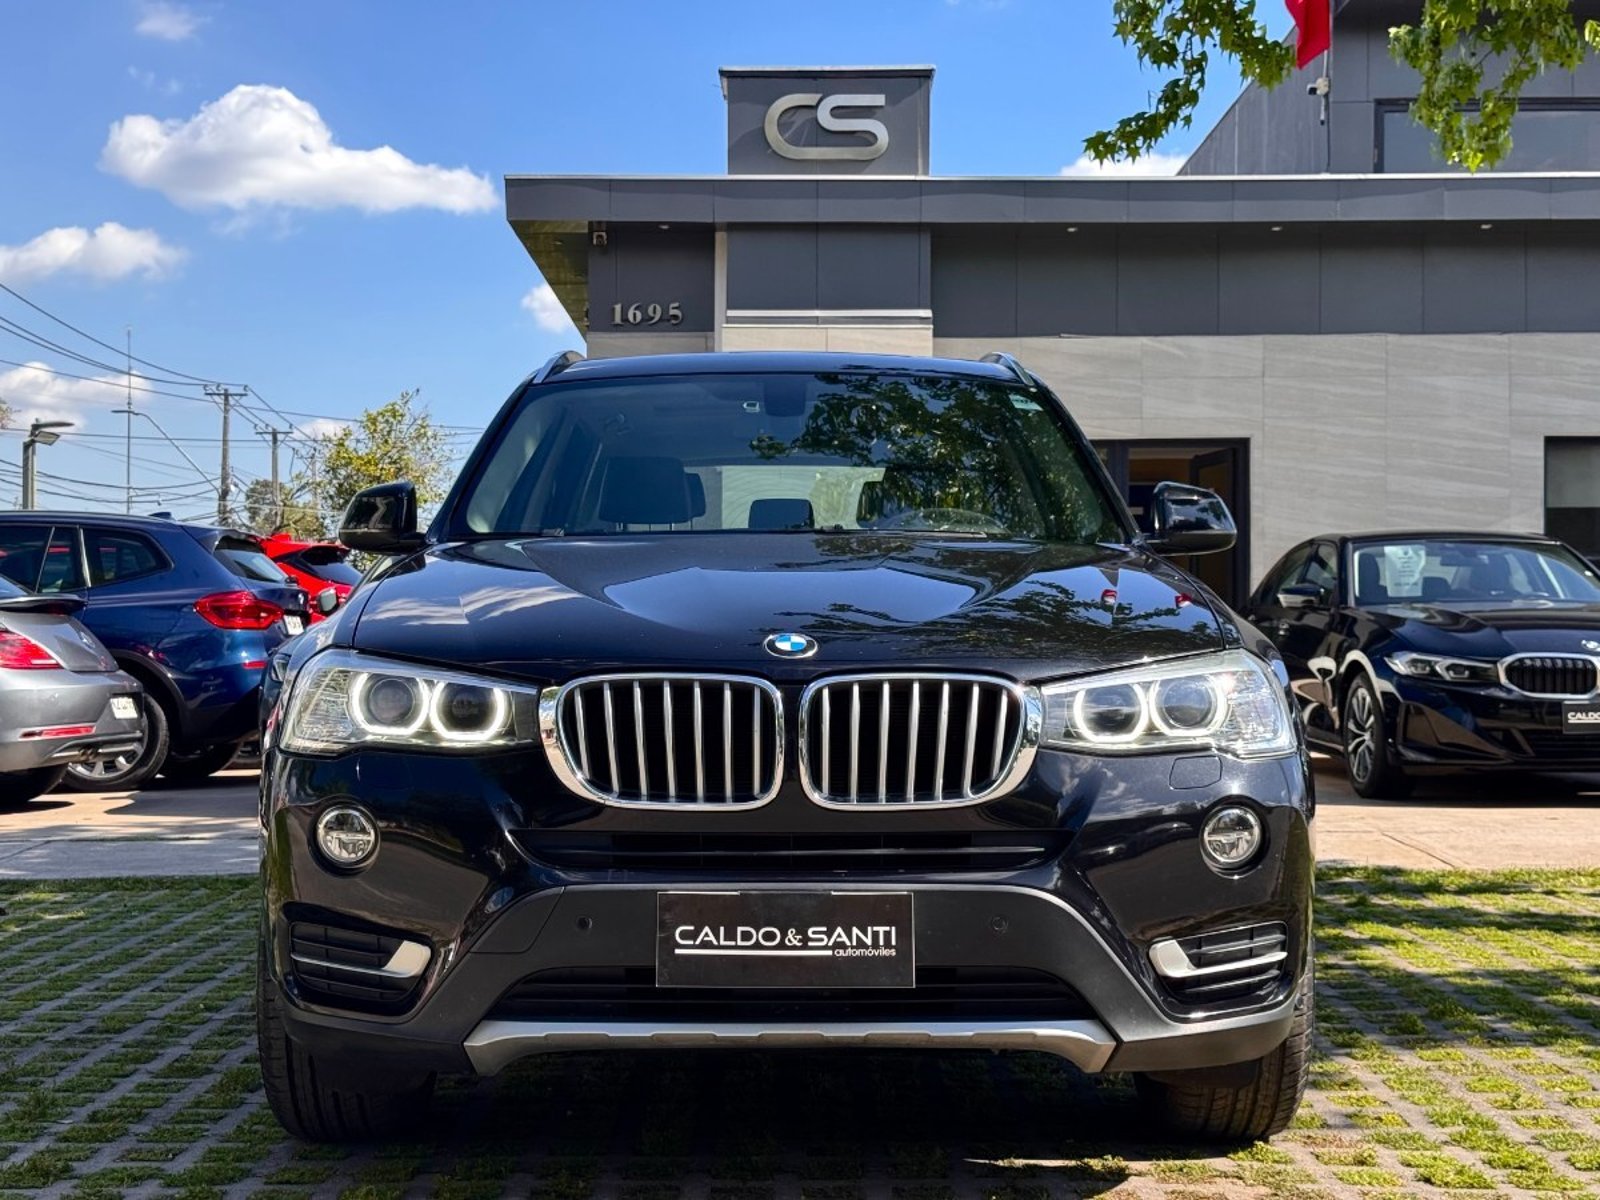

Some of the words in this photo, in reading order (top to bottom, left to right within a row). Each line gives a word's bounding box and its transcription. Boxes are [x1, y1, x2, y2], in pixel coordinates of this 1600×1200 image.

[764, 93, 889, 160] CS
[611, 302, 682, 325] 1695
[834, 947, 897, 957] automóviles
